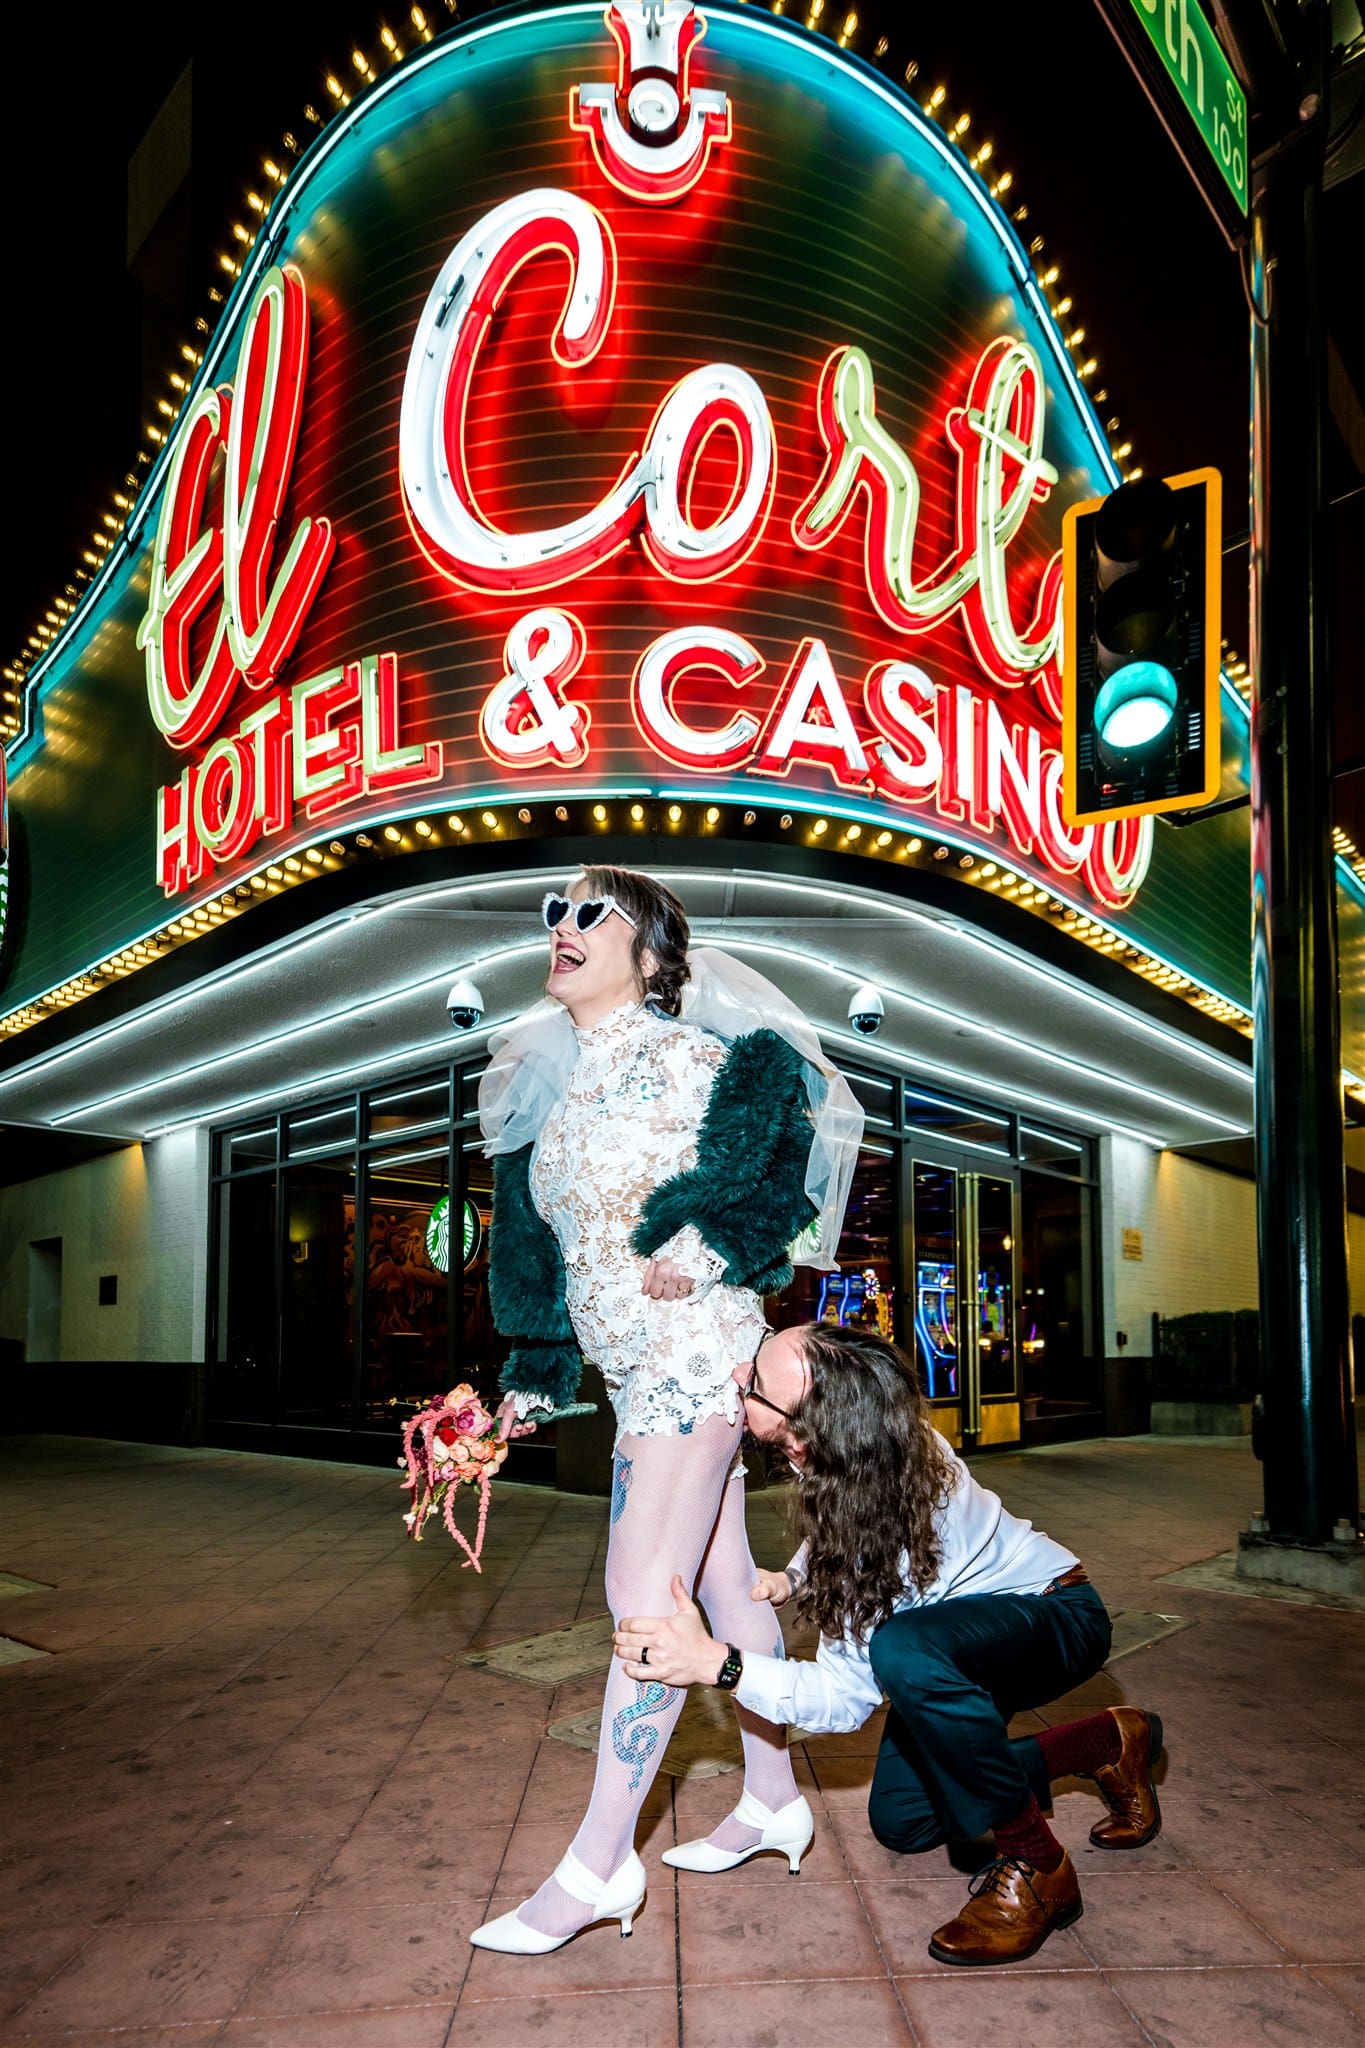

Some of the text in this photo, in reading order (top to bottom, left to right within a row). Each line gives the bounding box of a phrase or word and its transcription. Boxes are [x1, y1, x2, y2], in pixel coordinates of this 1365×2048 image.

[1140, 0, 1244, 138] th St
[1213, 106, 1244, 190] 100
[398, 186, 1155, 912] Cort
[156, 651, 444, 898] HOTEL
[479, 608, 592, 768] &
